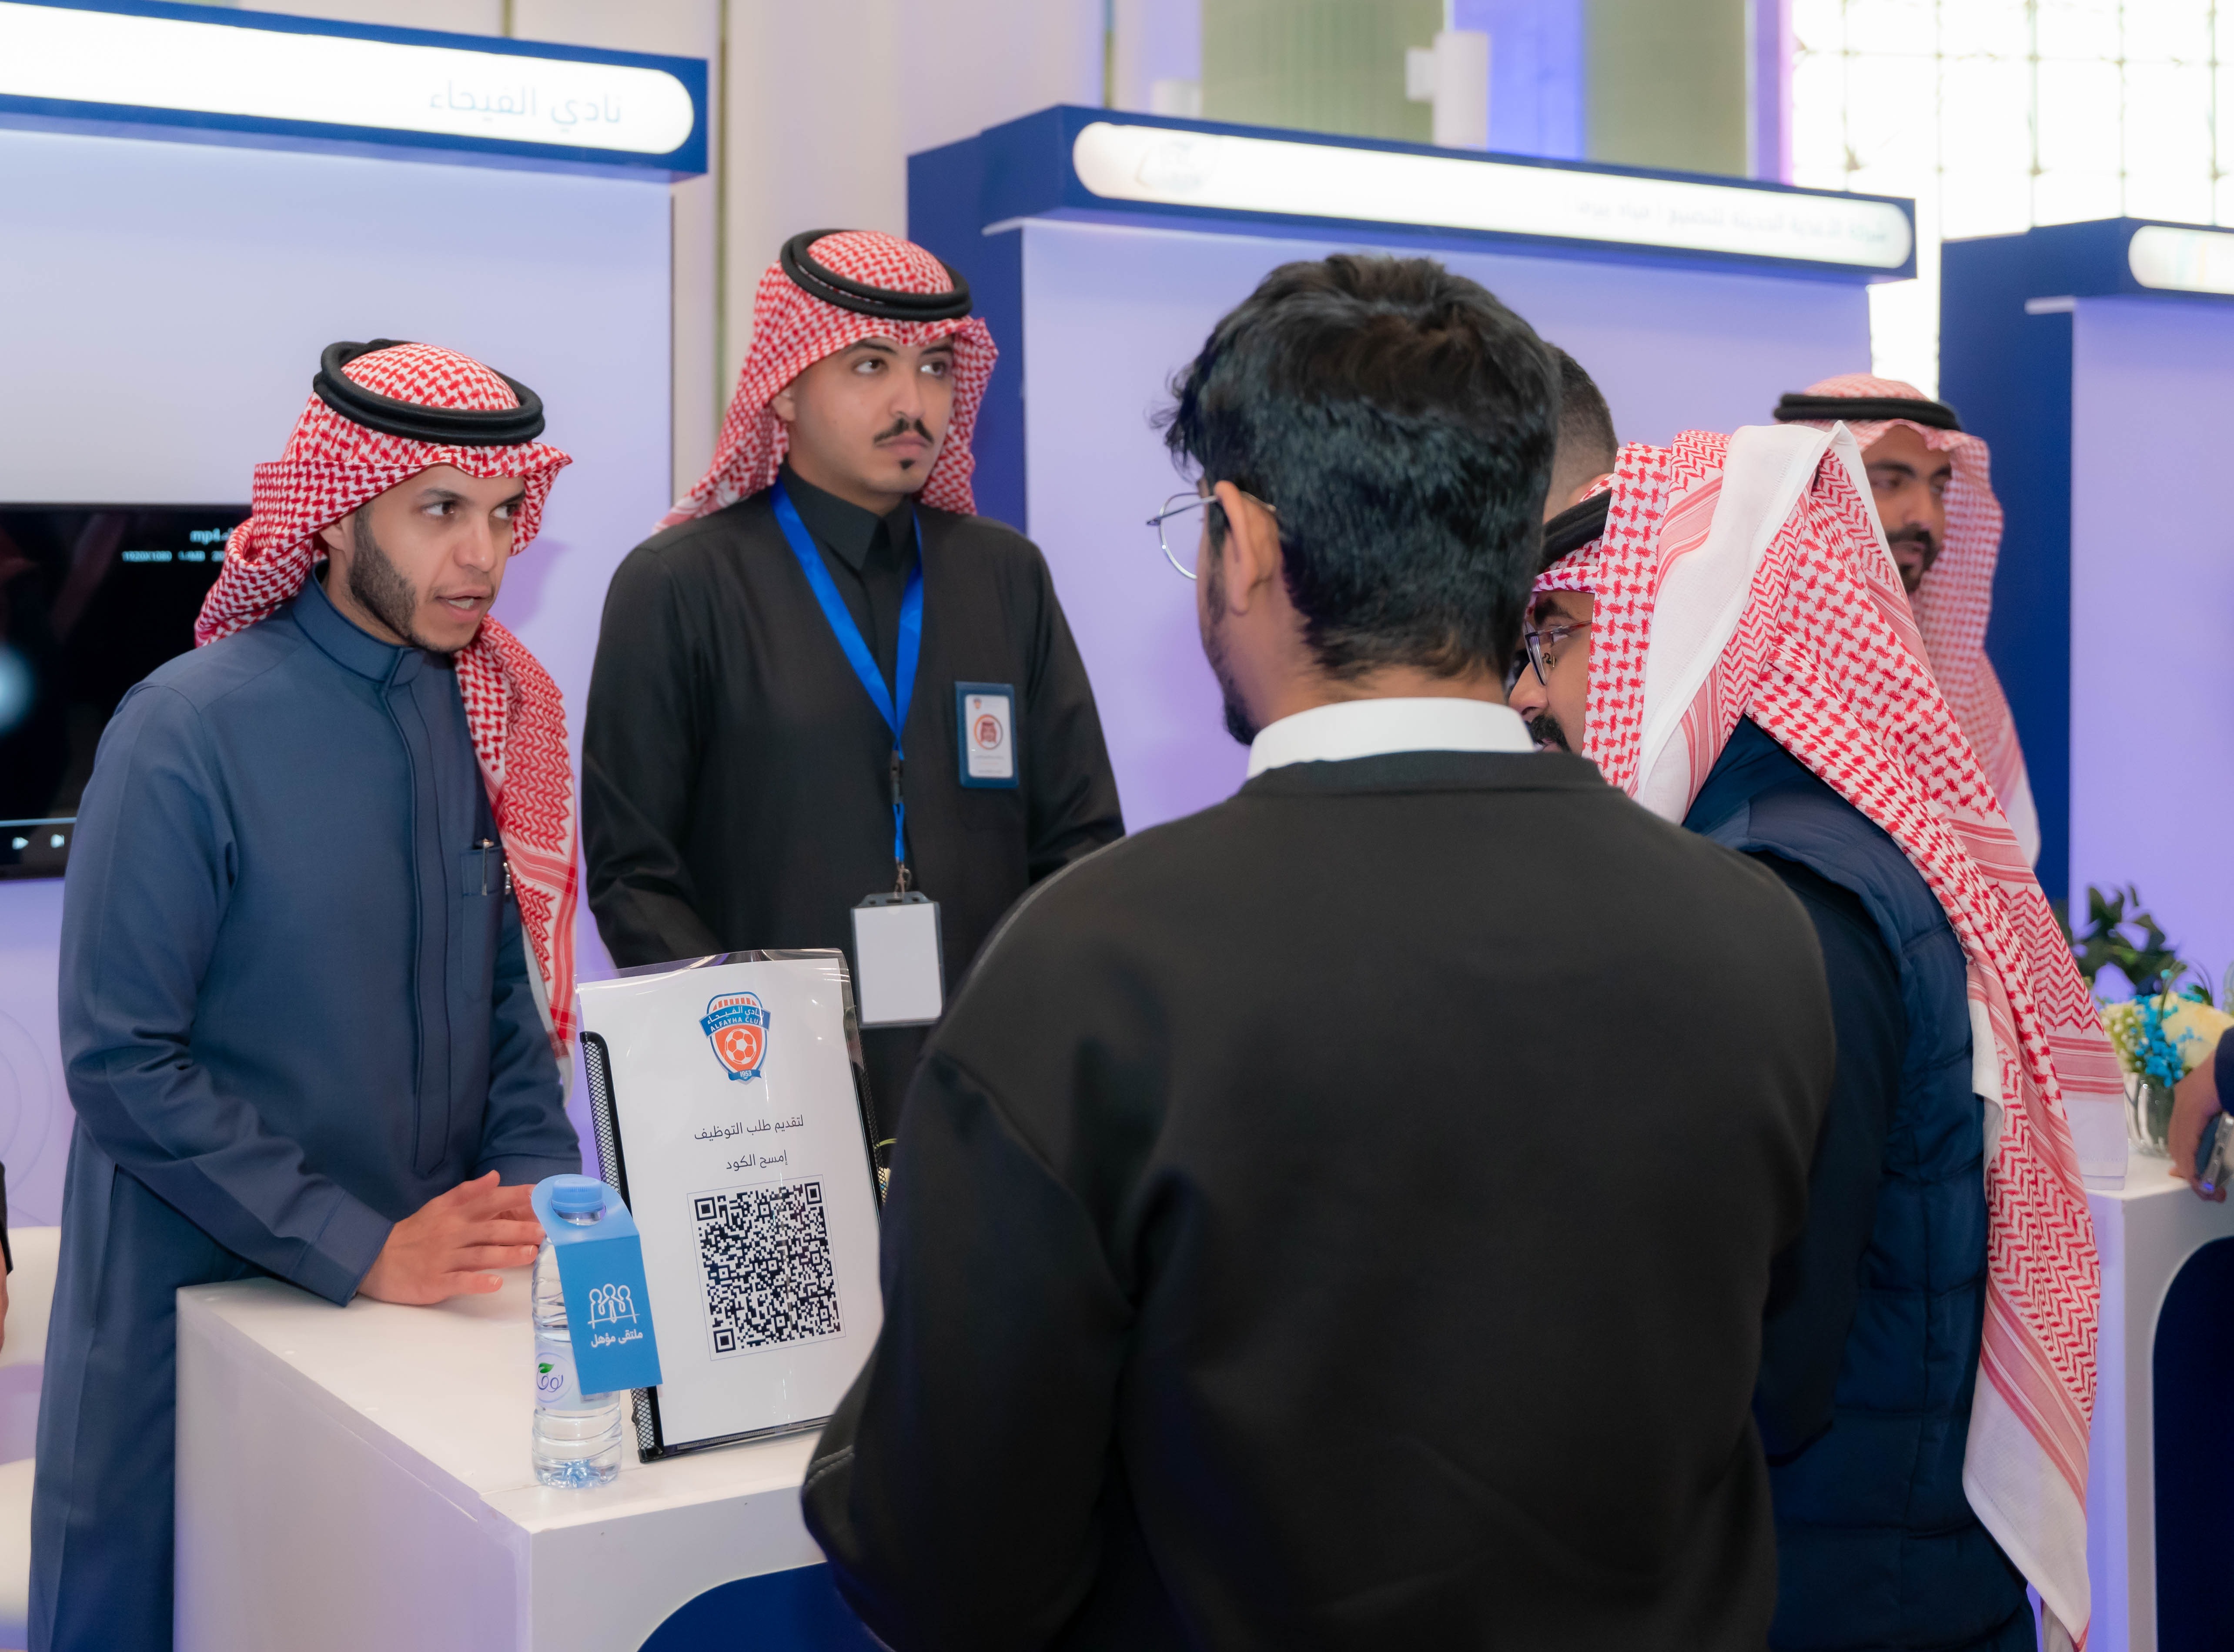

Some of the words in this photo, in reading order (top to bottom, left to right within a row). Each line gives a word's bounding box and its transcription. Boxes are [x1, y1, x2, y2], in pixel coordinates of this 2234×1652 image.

[429, 79, 536, 123] الفيحاء
[551, 93, 622, 133] نادي
[707, 1006, 742, 1025] الفيحاء
[745, 1008, 764, 1018] نادي
[710, 1017, 742, 1032] ALFAYHA
[745, 1017, 763, 1025] CLUB
[694, 1122, 743, 1141] التوظيف
[747, 1119, 771, 1136] طلب
[775, 1114, 804, 1132] لتقديم
[726, 1153, 756, 1171] الكود
[759, 1149, 788, 1168] إمسح
[591, 1332, 616, 1348] مؤهل
[618, 1328, 643, 1344] ملتقى
